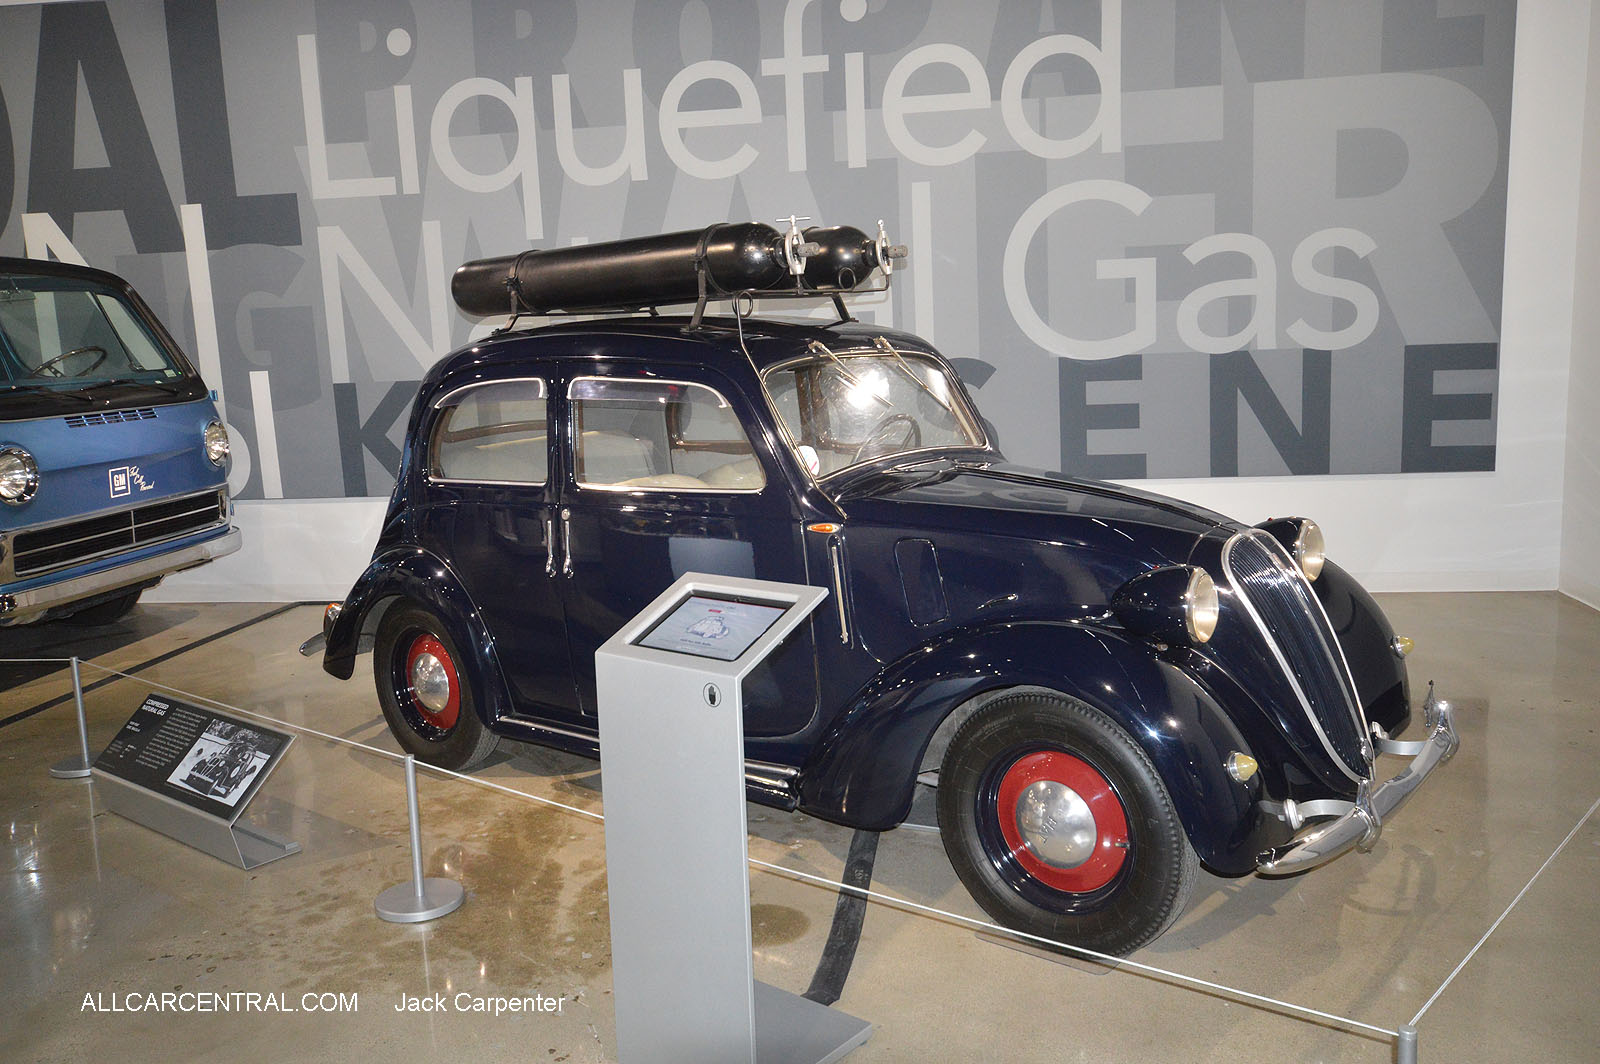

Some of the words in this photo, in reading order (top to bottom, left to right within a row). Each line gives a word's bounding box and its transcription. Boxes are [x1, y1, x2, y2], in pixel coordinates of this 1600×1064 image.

[0, 0, 302, 254] AL
[297, 0, 1122, 240] Liquefied
[1003, 180, 1380, 360] Gas
[114, 474, 126, 486] GM
